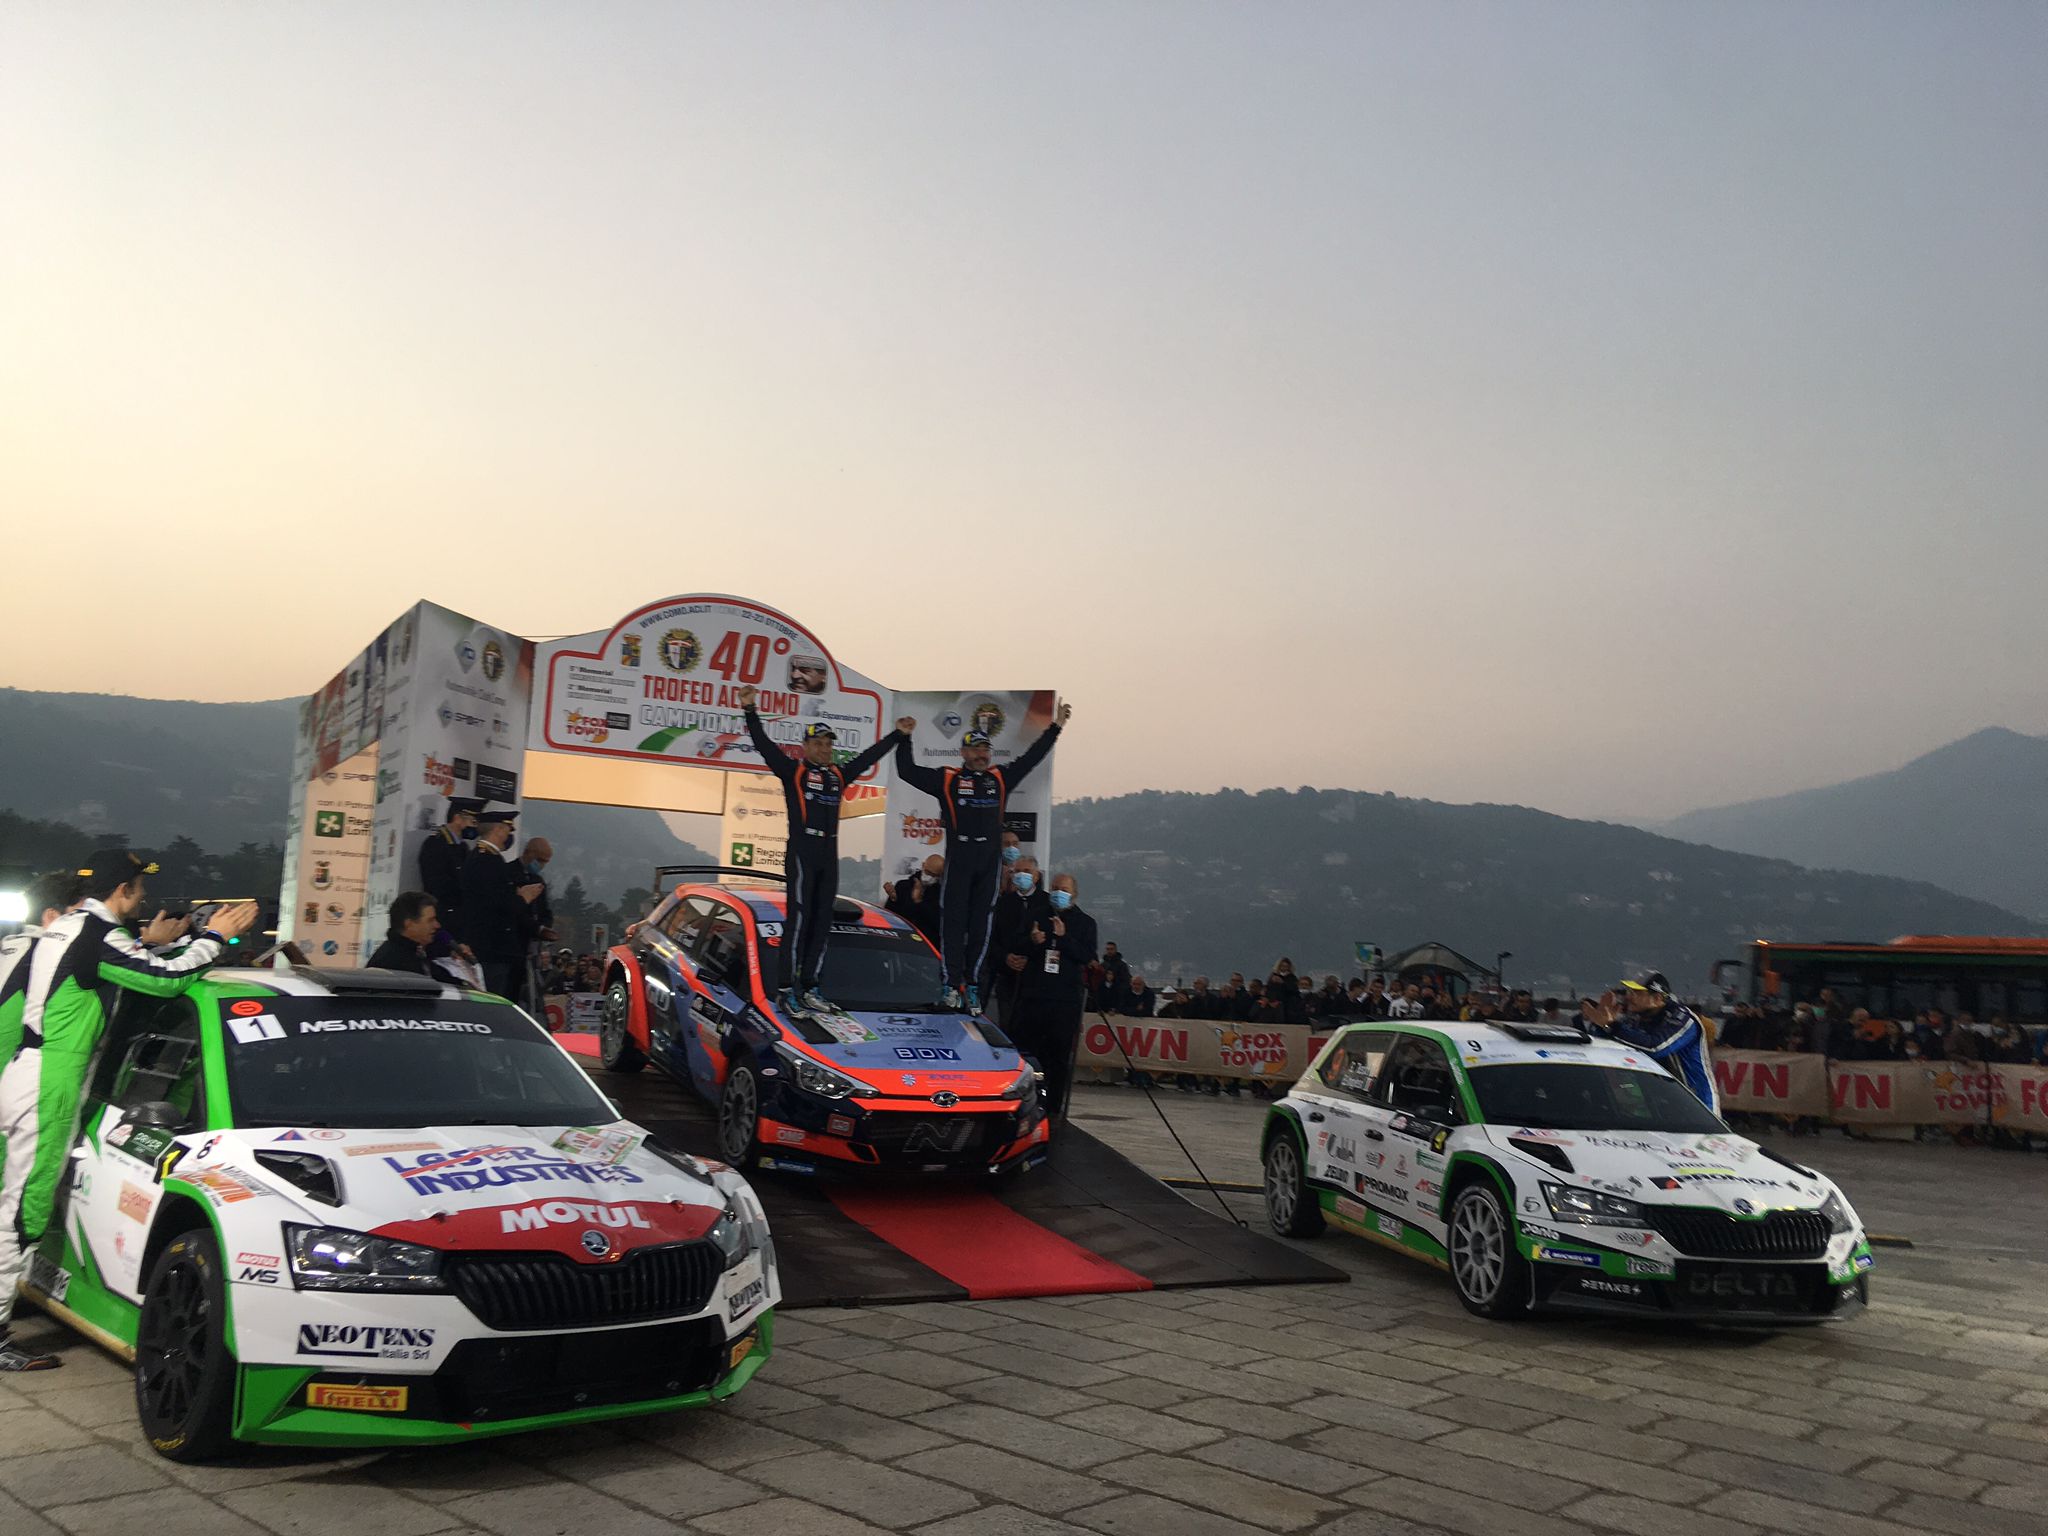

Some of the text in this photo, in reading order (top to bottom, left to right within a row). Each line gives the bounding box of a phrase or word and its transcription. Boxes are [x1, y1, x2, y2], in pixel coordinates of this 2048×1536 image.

[709, 630, 791, 684] 40°
[643, 674, 714, 706] TROFEO
[718, 684, 745, 710] AC
[766, 924, 778, 936] 3
[249, 1017, 269, 1038] 1
[300, 1019, 492, 1034] MS MUNARETTO
[1080, 1024, 1188, 1061] OWN
[1241, 1033, 1283, 1049] FOX
[1467, 1039, 1482, 1052] 9
[896, 1049, 953, 1059] BDV
[1219, 1051, 1287, 1066] TOWN
[776, 1129, 805, 1140] OMP
[404, 1163, 645, 1196] INDUSTRIES
[1363, 1174, 1409, 1204] PROMOX
[500, 1202, 650, 1233] MOTUL
[241, 1254, 278, 1265] MOTUL
[239, 1267, 280, 1284] MS
[299, 1324, 436, 1349] NEOTENS
[380, 1348, 430, 1360] Italia Srl
[316, 1387, 400, 1409] PIRELLI
